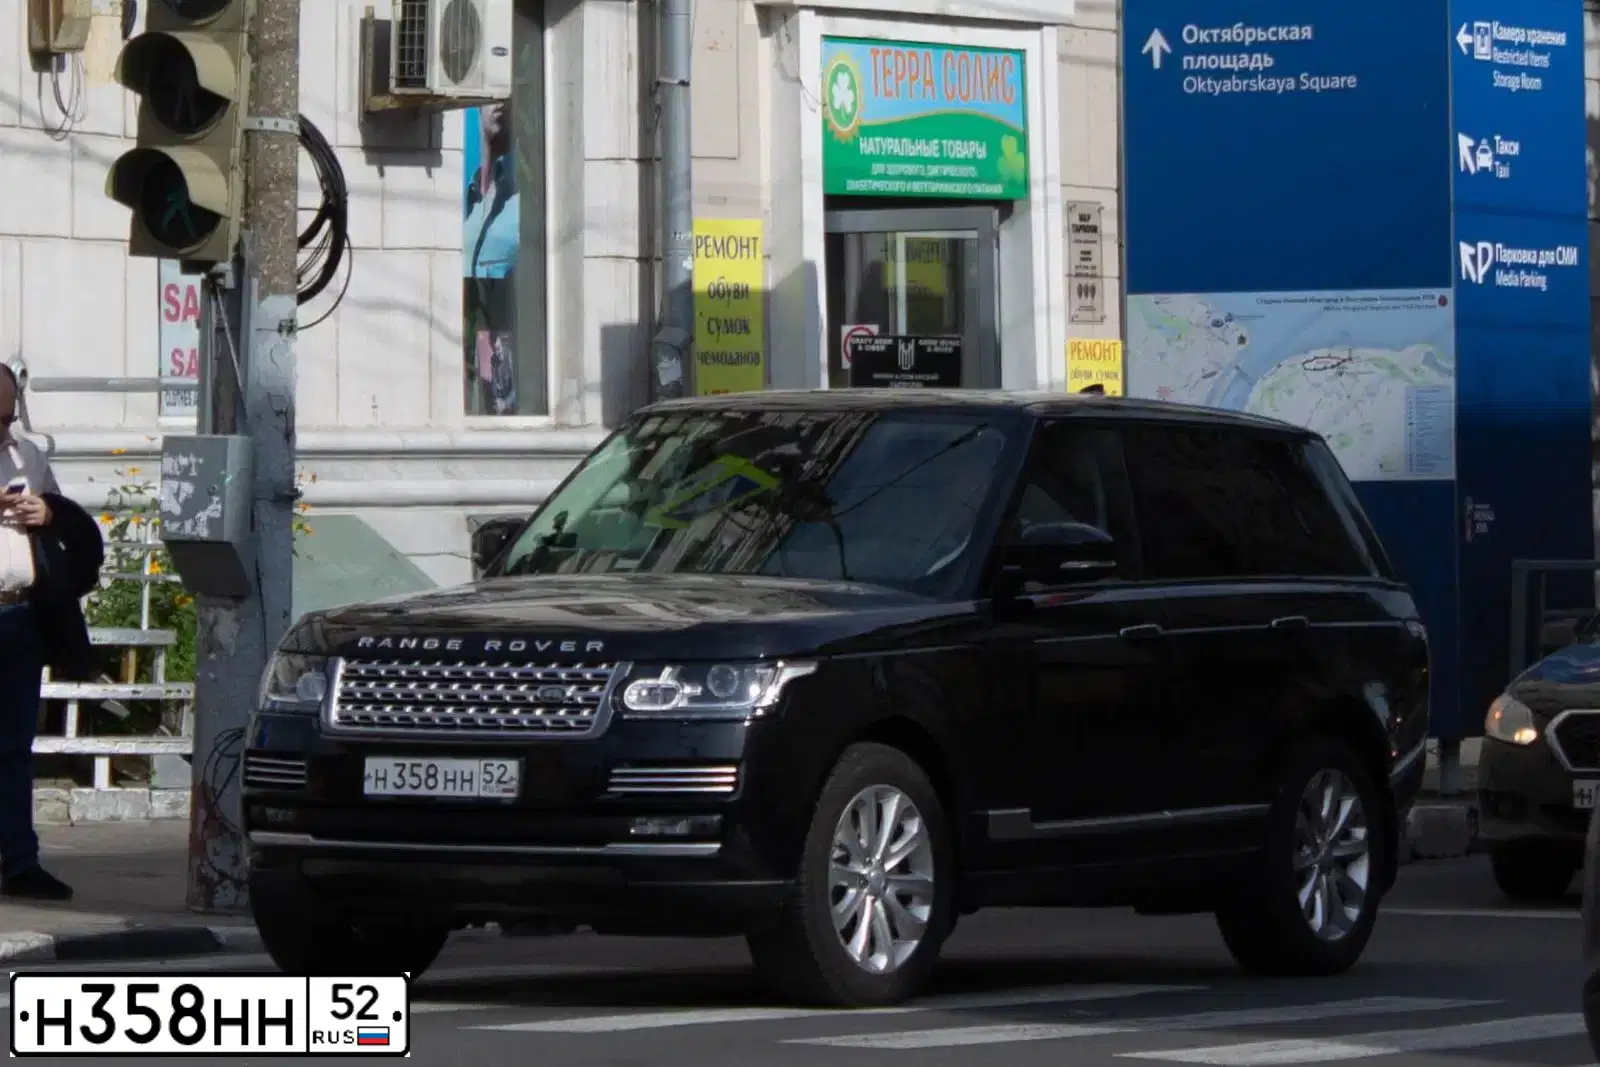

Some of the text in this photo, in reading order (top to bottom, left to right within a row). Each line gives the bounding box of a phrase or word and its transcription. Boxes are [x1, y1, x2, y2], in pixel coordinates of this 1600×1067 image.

[1182, 22, 1313, 46] Октябрьская
[1492, 20, 1526, 47] Камера
[1182, 52, 1274, 71] площадь
[870, 48, 1015, 105] ТЕРРА СОЛИС
[1183, 72, 1357, 96] Oktyabrskaya Square
[1521, 72, 1542, 91] Room
[859, 136, 988, 161] НАТУРАЛЬНЫЕ ТОВАРЫ
[1494, 134, 1519, 156] Такси
[695, 235, 759, 260] РЕМОНТ
[1495, 243, 1537, 268] Парковка
[1555, 245, 1579, 266] СМИ
[1495, 268, 1547, 292] Media Parking
[707, 276, 750, 309] обуви
[707, 316, 750, 344] сумок
[697, 351, 761, 367] чемоданов
[1070, 341, 1119, 362] РЕМОНТ
[358, 637, 605, 652] RANGE ROVER
[482, 763, 509, 785] 52
